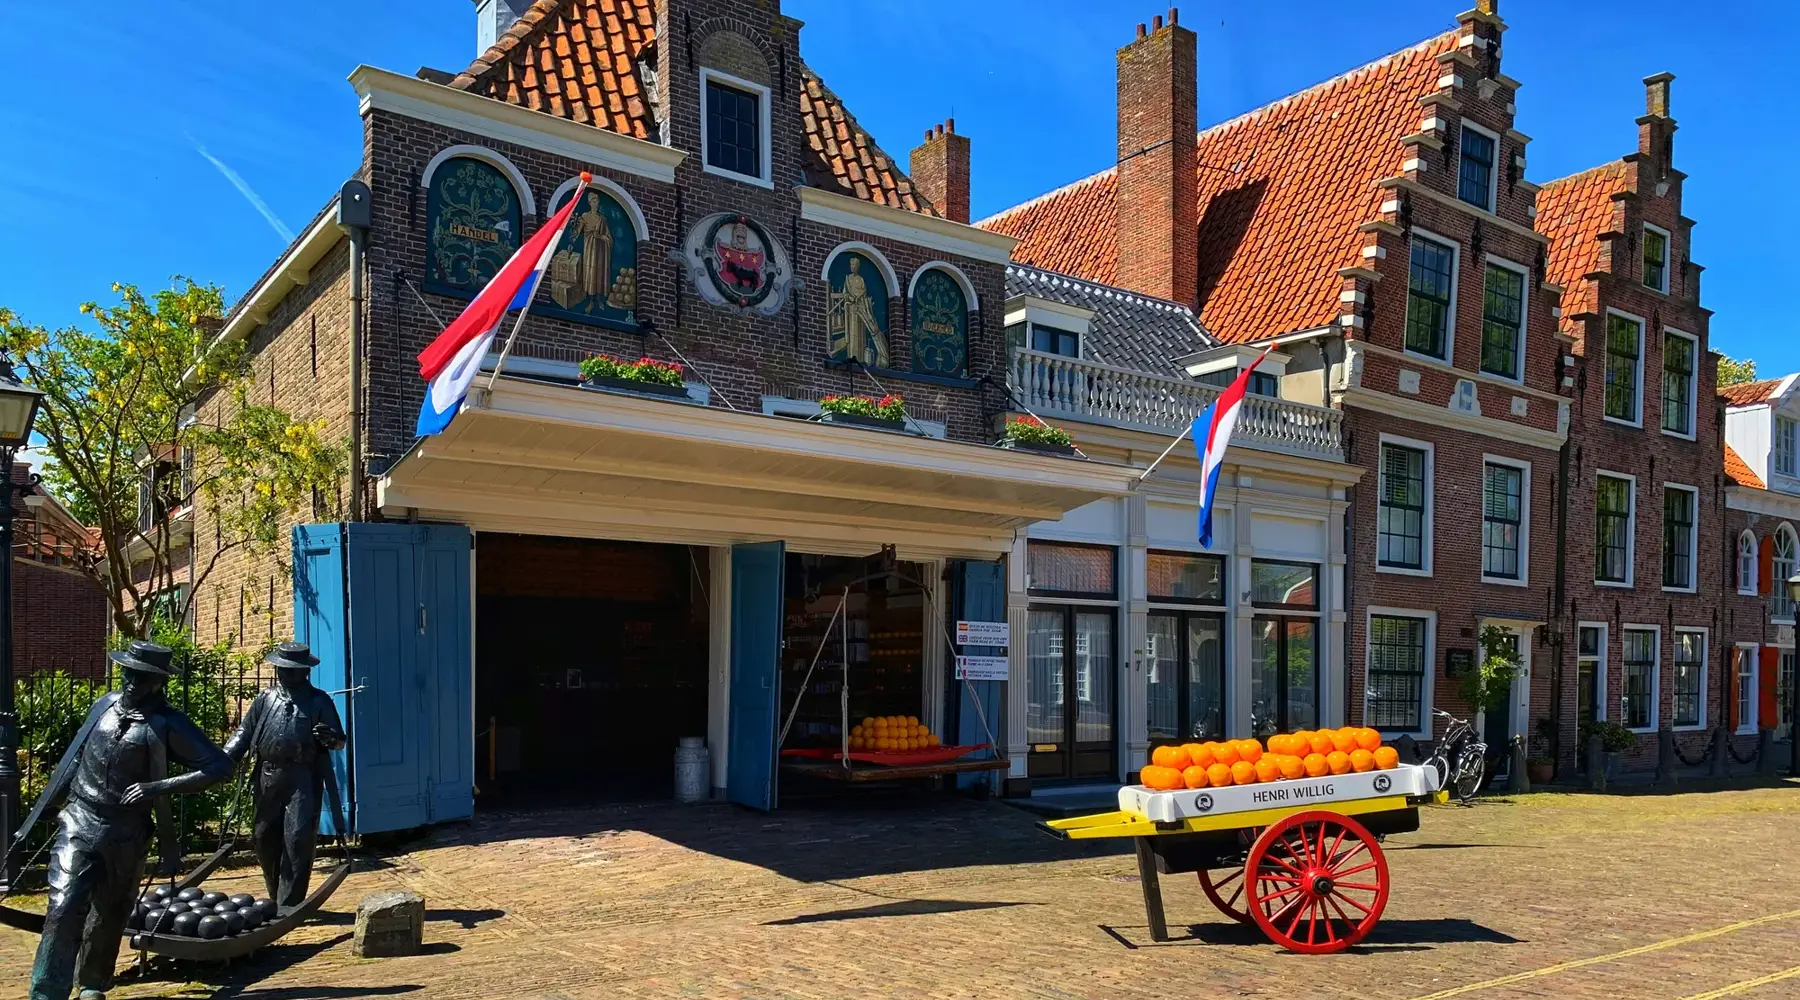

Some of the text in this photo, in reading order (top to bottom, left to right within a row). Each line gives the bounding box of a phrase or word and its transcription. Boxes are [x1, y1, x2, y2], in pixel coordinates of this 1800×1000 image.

[452, 225, 495, 241] HANDEL
[1253, 784, 1335, 803] HENRI WILLIG
